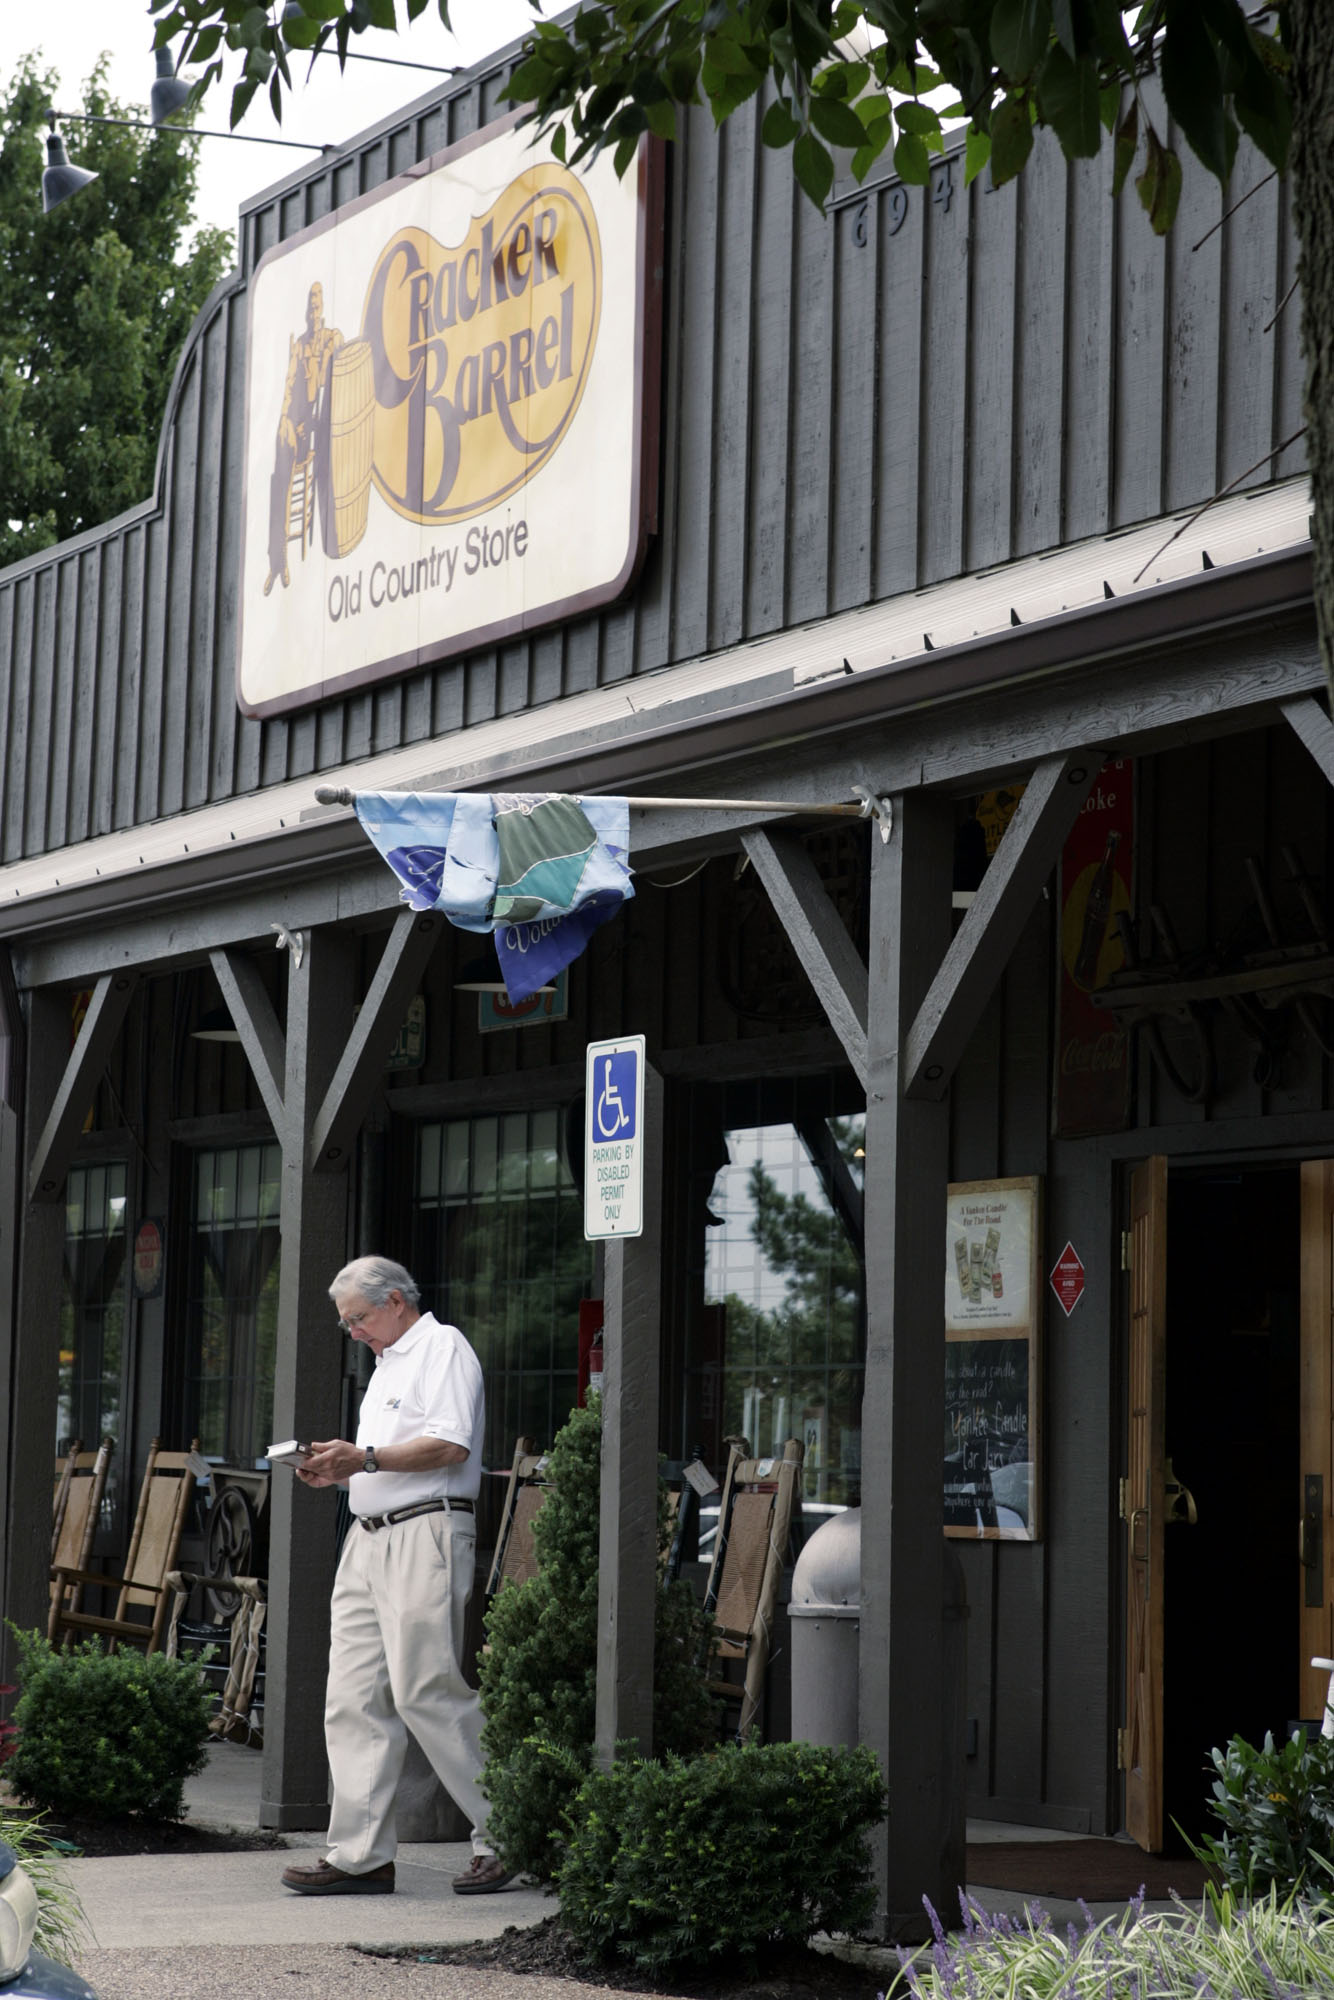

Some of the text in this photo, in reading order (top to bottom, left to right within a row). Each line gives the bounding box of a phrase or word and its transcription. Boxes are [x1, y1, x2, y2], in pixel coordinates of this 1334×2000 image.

[851, 157, 1001, 249] 694
[368, 206, 559, 409] Cracker
[403, 282, 575, 513] Barrel
[327, 518, 529, 622] Old Country Store
[1080, 786, 1117, 815] oke
[593, 1144, 634, 1163] PARKING BY
[597, 1164, 630, 1182] DISABLED
[601, 1184, 625, 1201] PERMIT
[604, 1204, 621, 1220] ONLY
